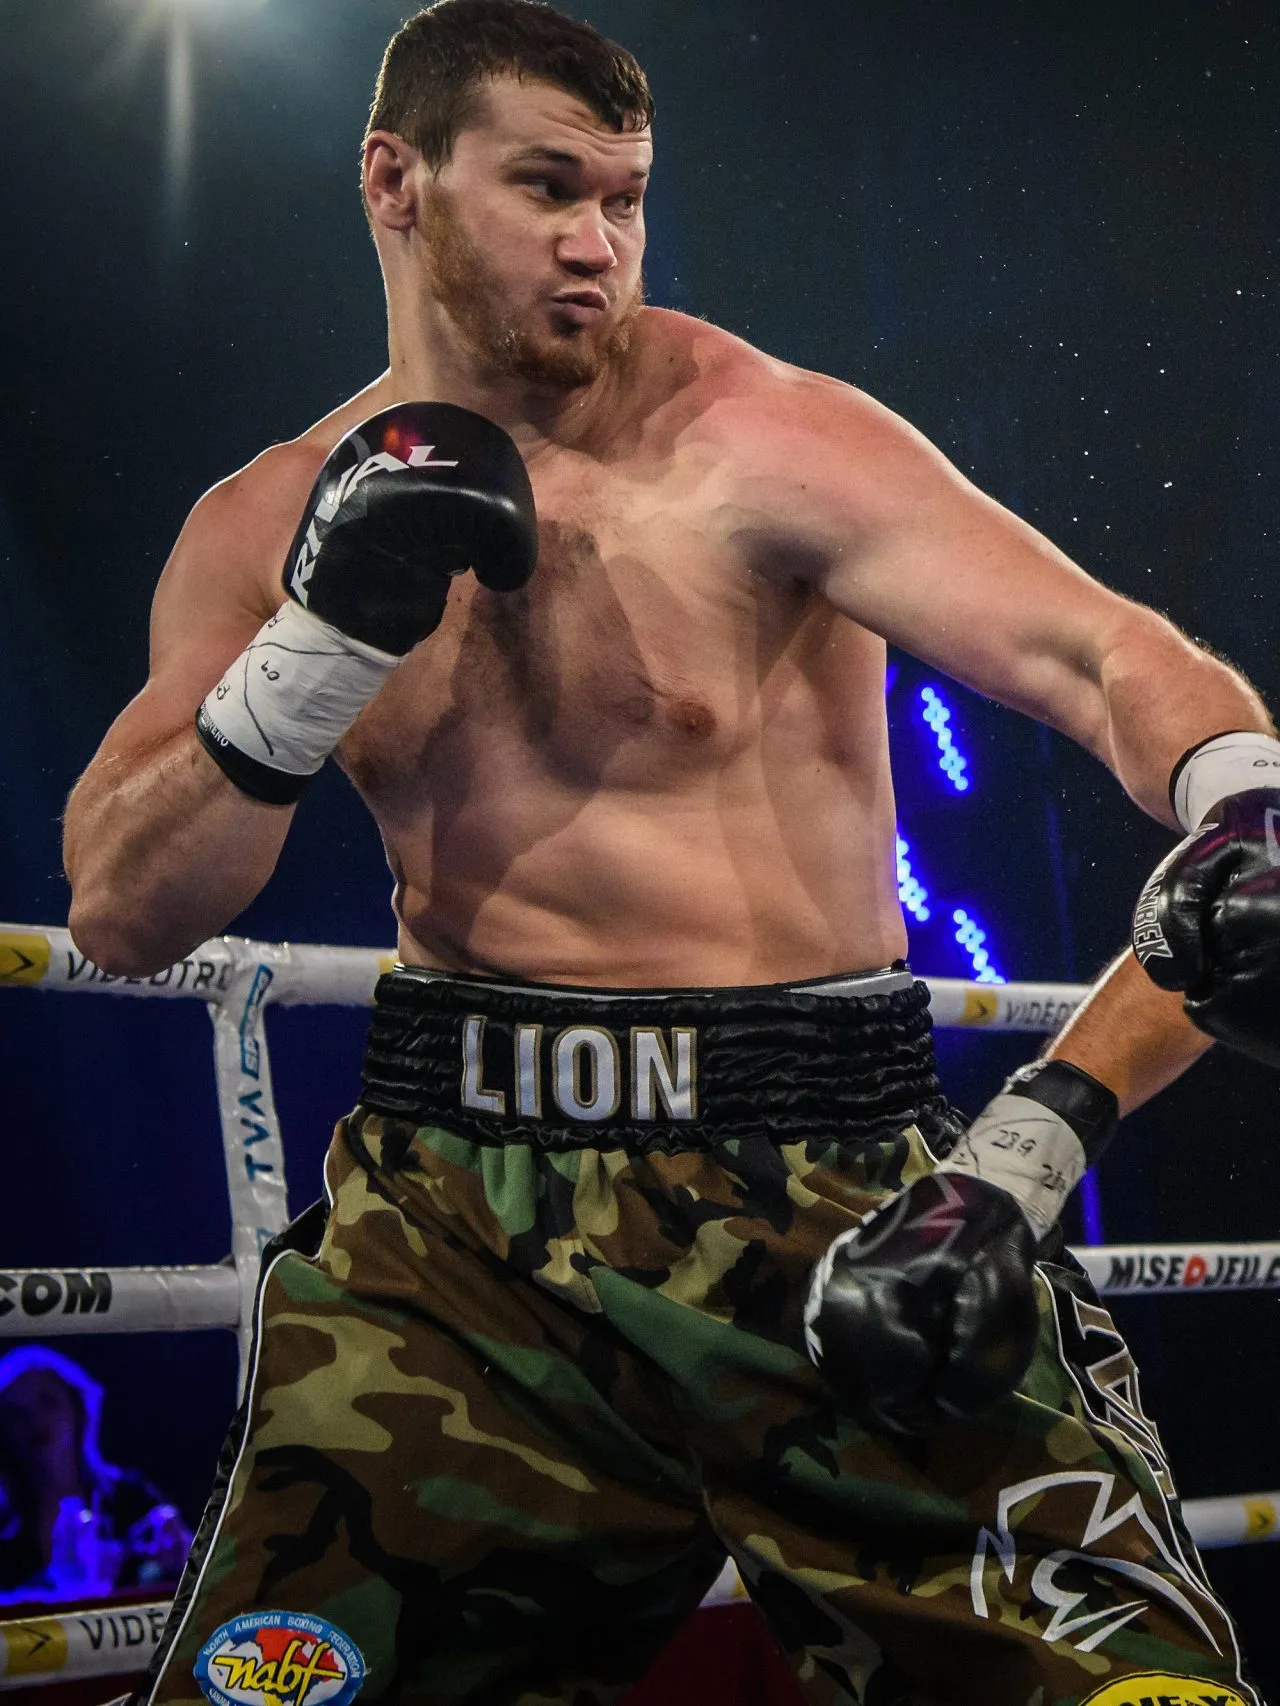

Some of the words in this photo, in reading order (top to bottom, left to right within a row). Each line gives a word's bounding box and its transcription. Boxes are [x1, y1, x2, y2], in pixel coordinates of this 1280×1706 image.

[291, 445, 459, 608] RIVAL
[461, 1015, 697, 1121] LION
[239, 1090, 273, 1181] TVA
[203, 1630, 230, 1656] NORTH
[234, 1615, 281, 1633] AMERICAN
[287, 1617, 324, 1634] BOXING
[327, 1630, 361, 1678] FEDERATION
[212, 1638, 347, 1706] nabf
